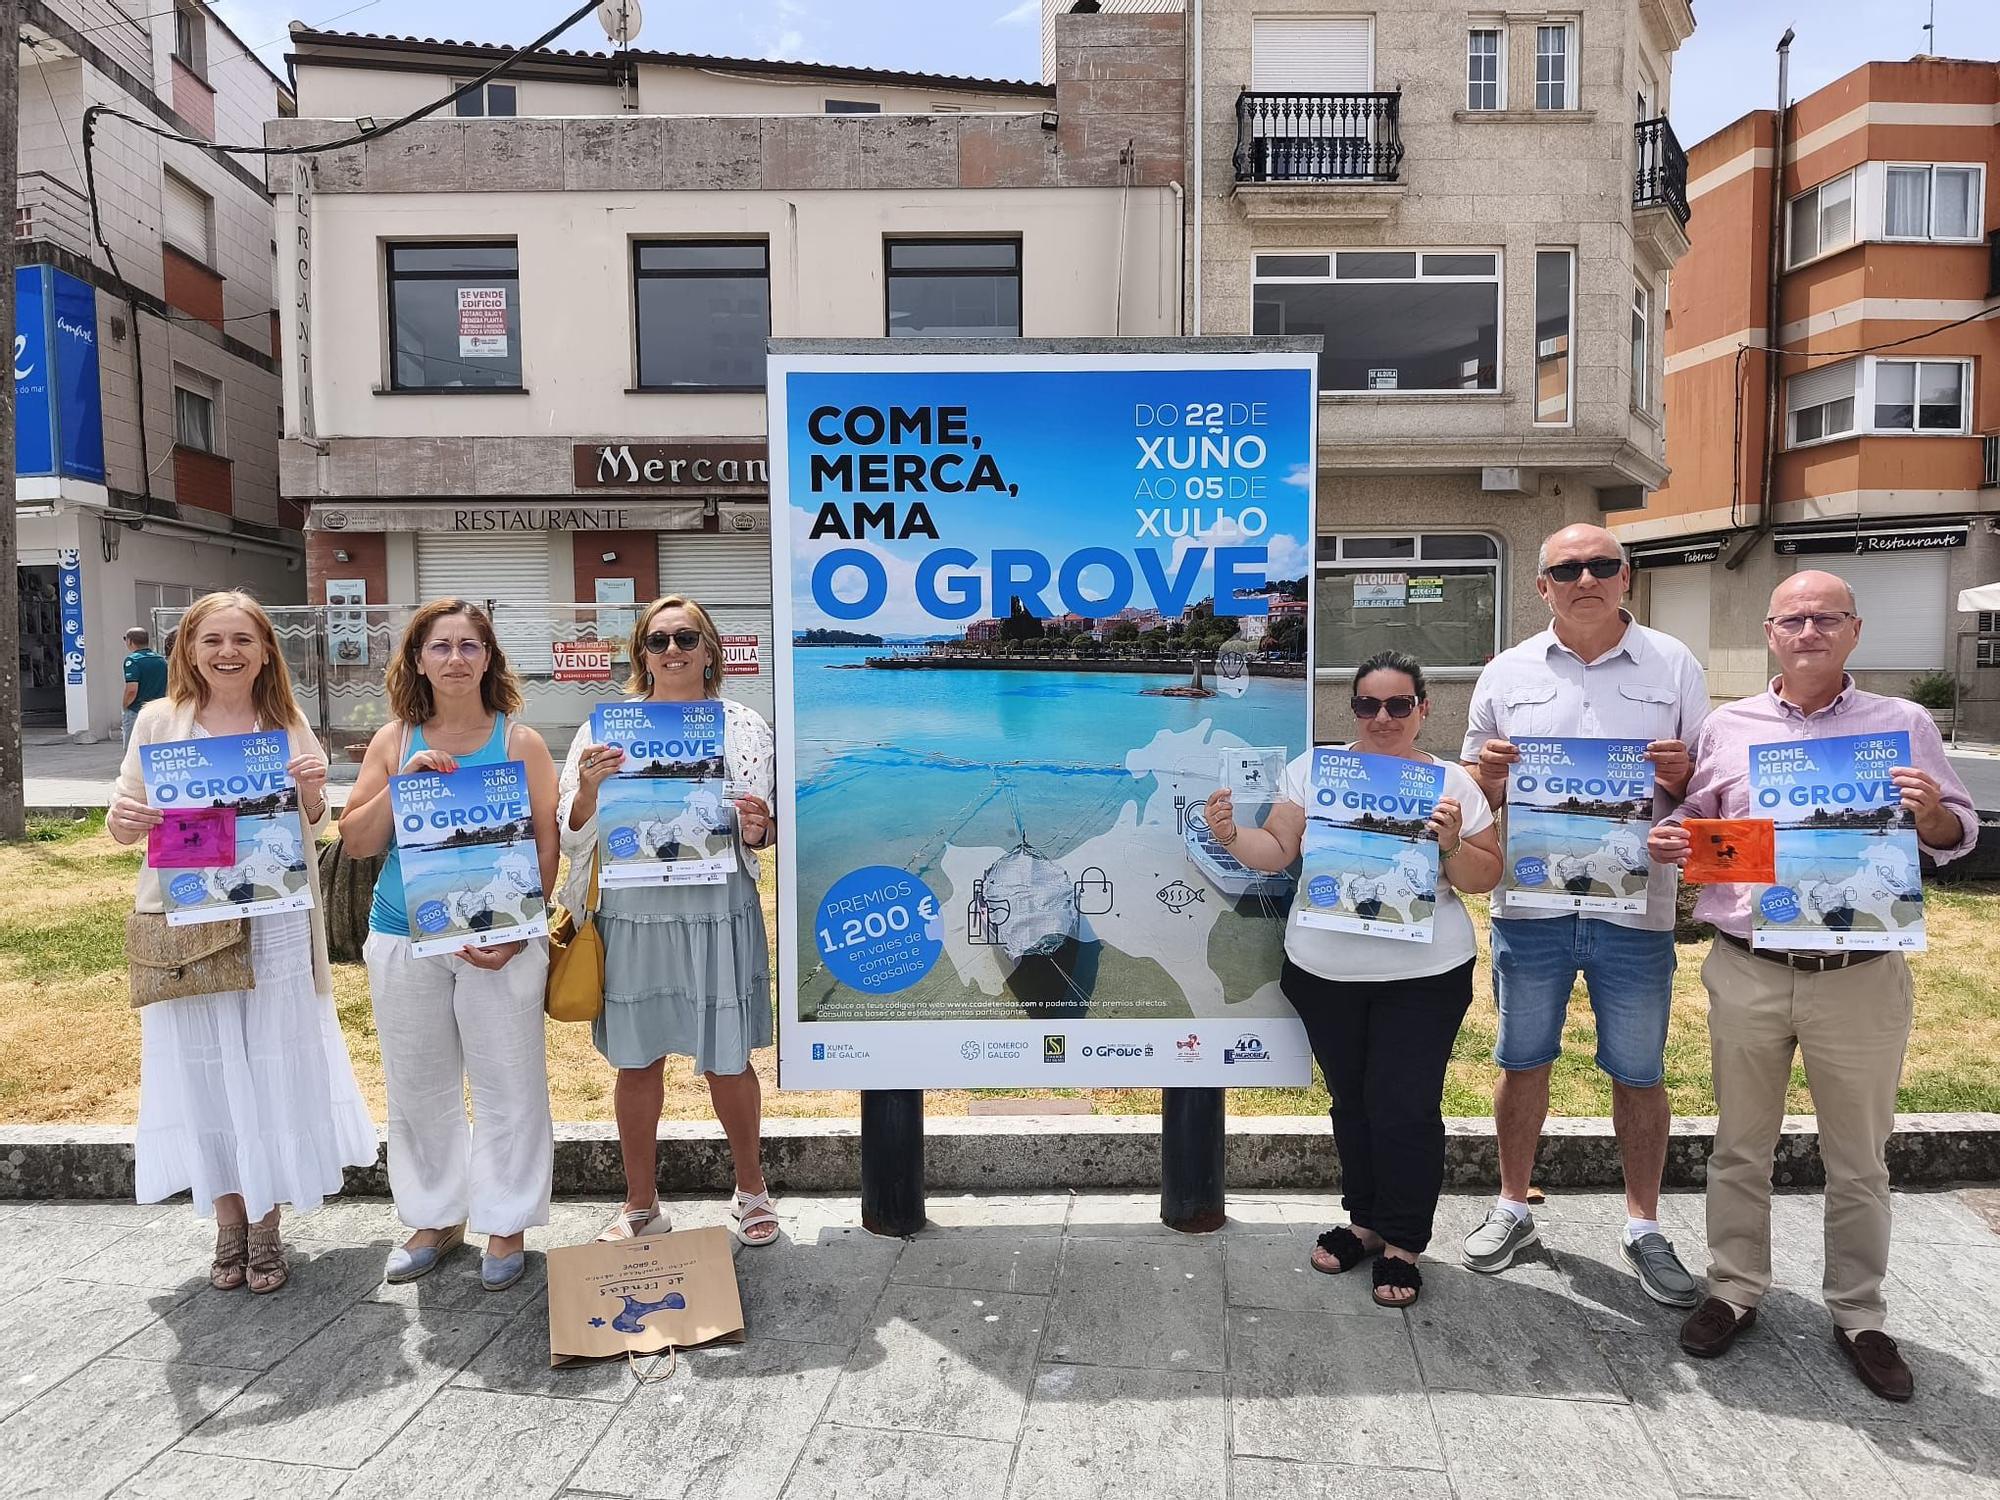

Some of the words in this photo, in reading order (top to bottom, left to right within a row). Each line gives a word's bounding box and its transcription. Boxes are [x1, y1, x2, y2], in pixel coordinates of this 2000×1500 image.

[462, 300, 502, 308] EDIFICIO
[31, 385, 45, 393] mar
[1135, 403, 1178, 427] DO
[1185, 403, 1224, 426] 22
[1230, 402, 1267, 426] DE
[807, 405, 982, 450] COME,
[1135, 425, 1267, 470] XUÑO
[811, 454, 1019, 498] MERCA,
[1135, 477, 1177, 500] AO
[1185, 477, 1224, 500] 05
[1229, 477, 1267, 499] DE
[454, 509, 629, 531] RESTAURANTE
[808, 502, 940, 539] AMA
[1135, 506, 1268, 538] XULLO
[1869, 534, 1960, 550] Restaurante
[1684, 551, 1716, 563] Taberna
[811, 547, 887, 620] O
[915, 546, 1268, 619] GROVE
[1354, 573, 1405, 585] ALQUILA
[554, 654, 609, 668] VENDE
[604, 730, 636, 740] AMA
[683, 730, 715, 738] XULLO
[242, 738, 254, 746] DO
[255, 737, 267, 745] 22
[1854, 741, 1868, 749] DO
[1869, 740, 1883, 749] 22
[1883, 739, 1897, 748] DE
[630, 739, 715, 758] GROVE
[246, 762, 282, 774] XULLO
[1402, 763, 1414, 771] DO
[1517, 765, 1552, 776] AMA
[1871, 761, 1884, 769] 05
[154, 771, 192, 784] AMA
[482, 769, 494, 777] DO
[495, 768, 505, 776] 22
[505, 767, 516, 775] DE
[1607, 770, 1645, 779] XULLO
[1855, 771, 1890, 780] XULL
[156, 784, 178, 802] O
[186, 771, 285, 799] GROVE
[1318, 779, 1349, 789] AMA
[1412, 781, 1424, 789] 05
[1517, 776, 1537, 792] O
[1545, 777, 1644, 797] GROVE
[1759, 775, 1795, 787] AMA
[486, 792, 520, 803] XULLO
[1399, 787, 1434, 798] XULLO
[1759, 788, 1780, 807] O
[1789, 781, 1901, 806] GROVE
[401, 801, 435, 814] AMA
[1317, 789, 1336, 806] O
[1343, 791, 1433, 816] GROVE
[403, 814, 423, 832] O
[430, 801, 522, 829] GROVE
[827, 881, 912, 918] PREMIOS
[819, 905, 910, 953] 1.200
[917, 895, 938, 921] €
[849, 949, 866, 961] en
[869, 939, 902, 955] vales
[904, 932, 921, 946] de
[858, 951, 909, 973] compra
[911, 946, 920, 956] e
[863, 959, 924, 986] agasallos
[817, 1002, 854, 1010] Introduce
[947, 1000, 1037, 1009] www.ccadetendas.com
[1079, 1000, 1100, 1008] obter
[1102, 1000, 1134, 1008] premios
[817, 1010, 851, 1018] Consulta
[907, 1009, 973, 1018] establecementos
[988, 1042, 1029, 1050] COMERCIO
[1235, 1039, 1263, 1051] 40
[988, 1051, 1020, 1059] GALEGO
[1082, 1046, 1093, 1057] O
[623, 1261, 649, 1271] GROVE
[668, 1276, 685, 1286] de
[599, 1281, 659, 1297] tendas
